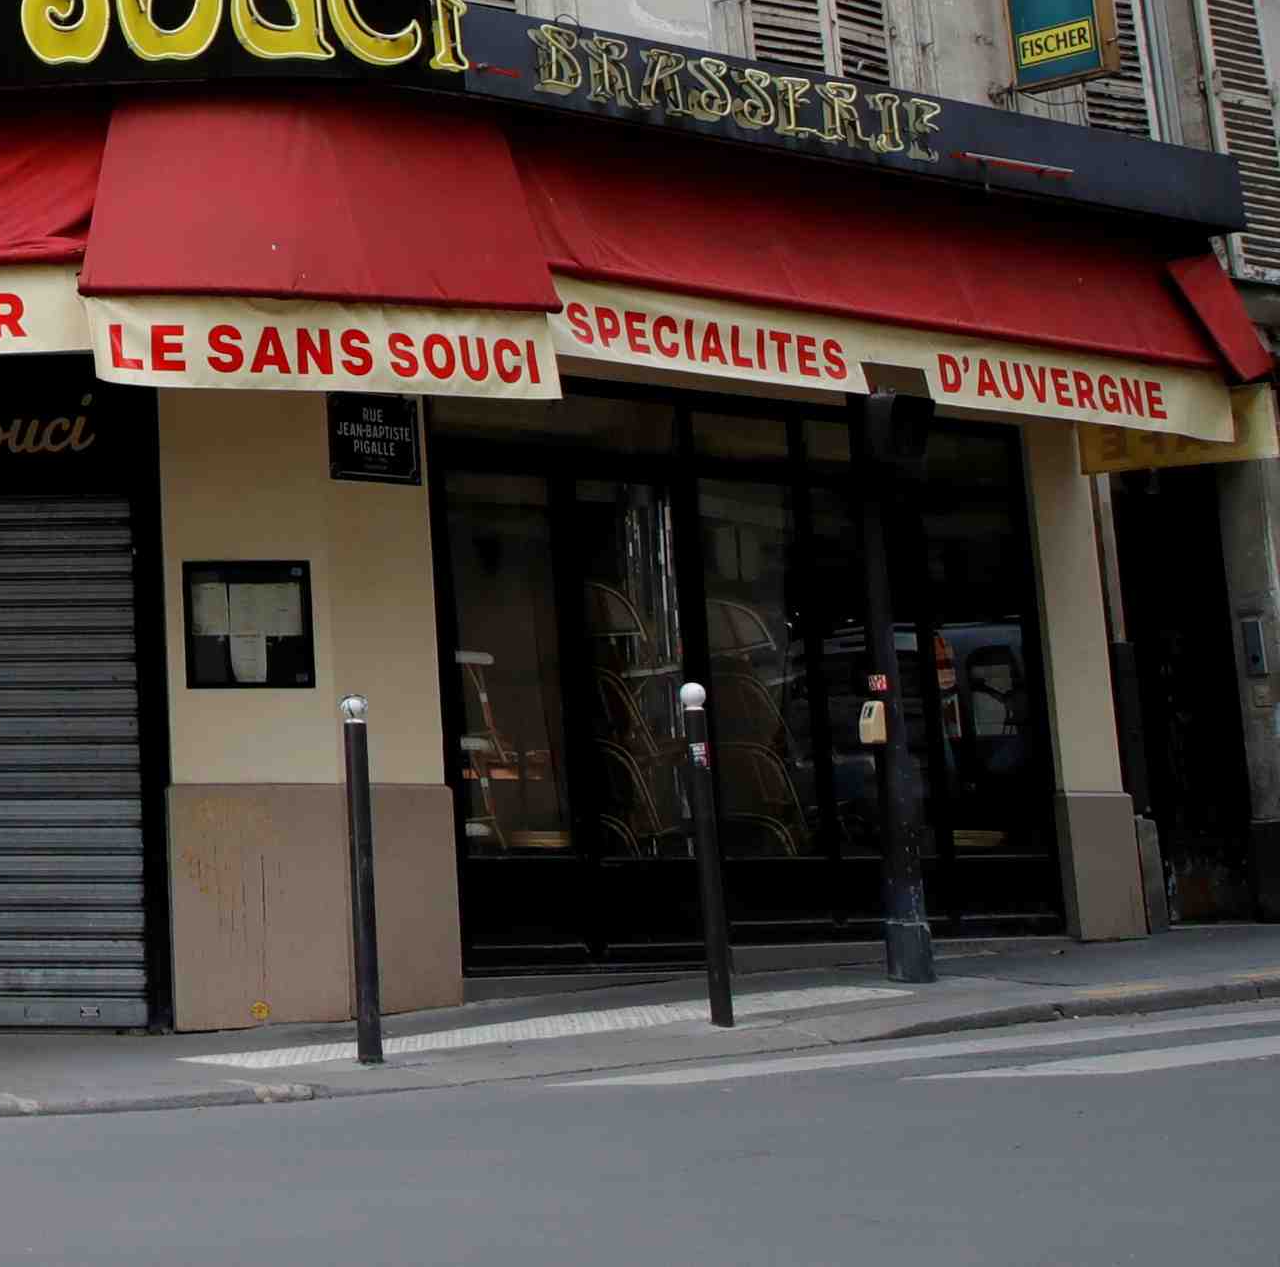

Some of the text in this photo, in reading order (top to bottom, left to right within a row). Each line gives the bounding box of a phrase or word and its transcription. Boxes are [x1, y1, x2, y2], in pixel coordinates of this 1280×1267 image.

[1021, 26, 1089, 62] FISCHER
[528, 23, 942, 164] BRASSERIE
[107, 322, 542, 384] LE SANS SOUCI
[566, 301, 1169, 421] SPECIALITES D'AUVERGNE
[336, 421, 412, 442] JEAN-BAPTISTE
[362, 407, 383, 422] RUE
[353, 439, 396, 457] PIGALLE
